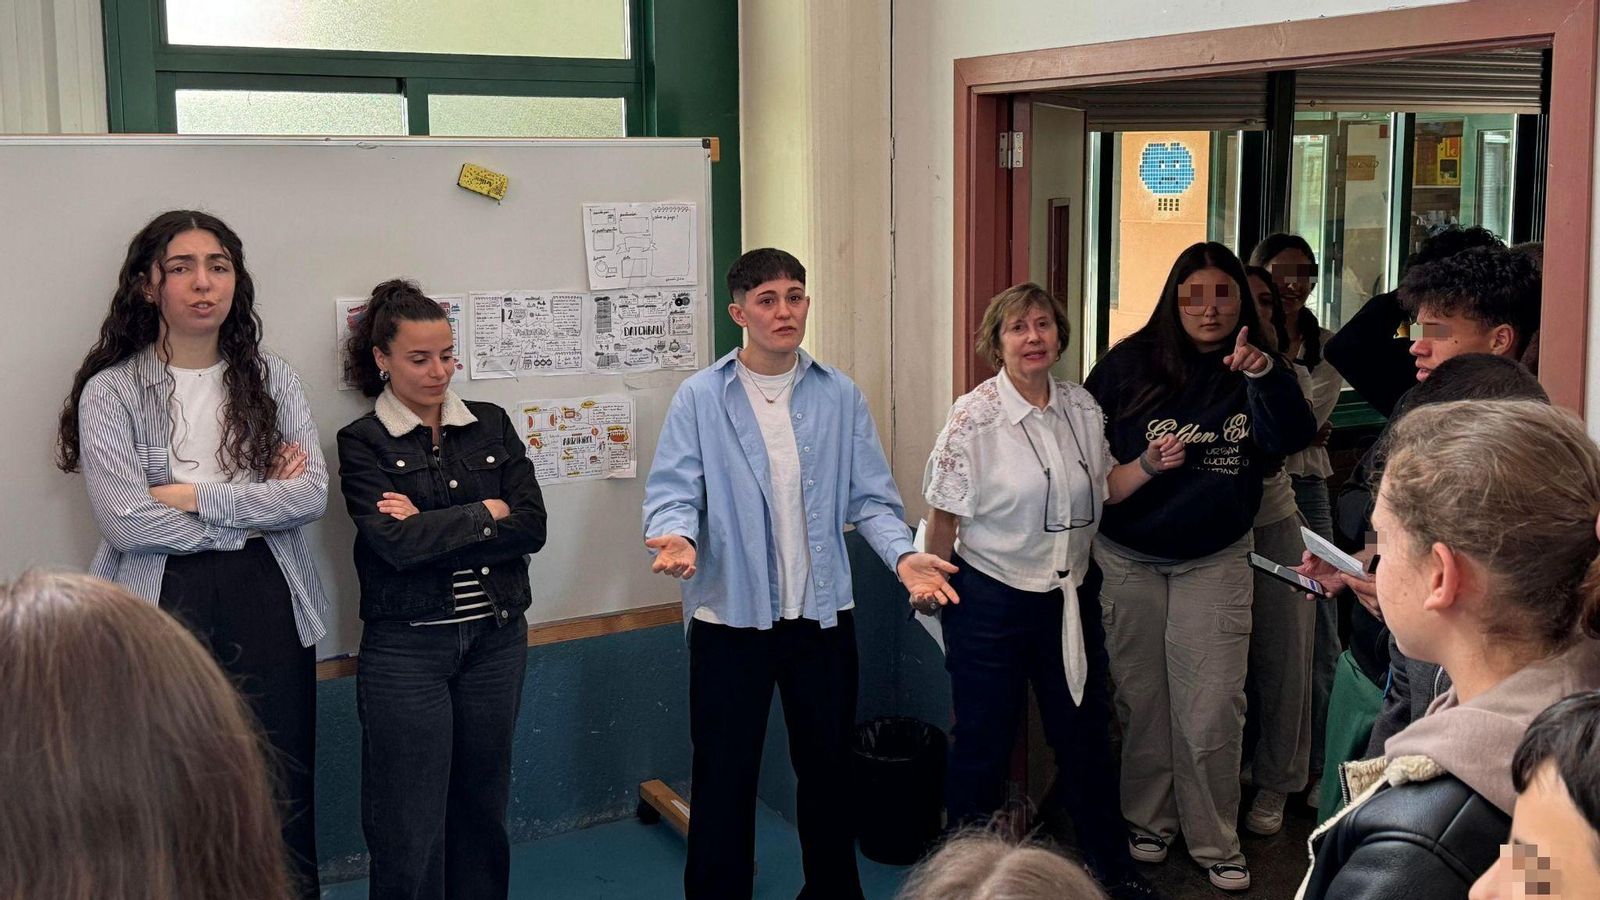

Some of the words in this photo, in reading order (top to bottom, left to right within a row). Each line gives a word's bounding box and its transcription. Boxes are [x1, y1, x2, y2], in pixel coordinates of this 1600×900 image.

[624, 325, 663, 337] DATCHBALL
[1146, 418, 1219, 444] Glden
[1206, 445, 1240, 456] URBAN
[1203, 455, 1241, 466] CULTURE
